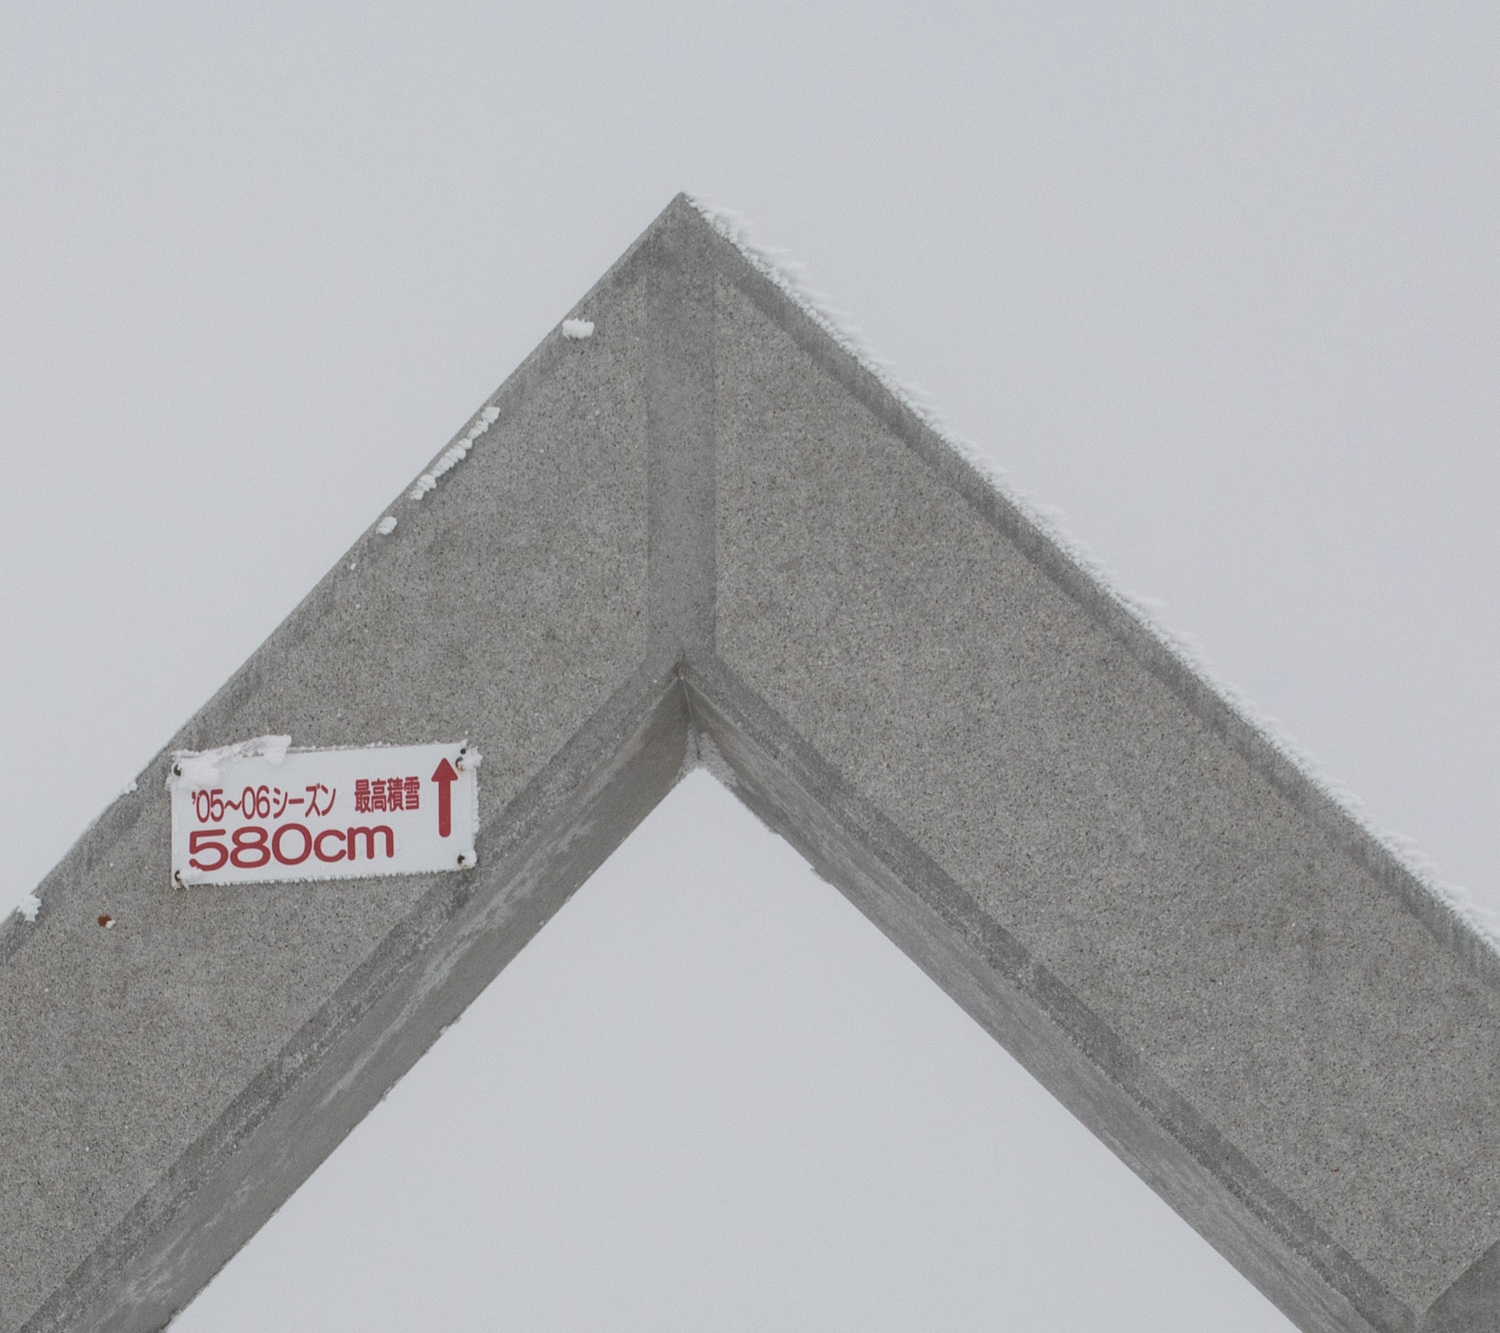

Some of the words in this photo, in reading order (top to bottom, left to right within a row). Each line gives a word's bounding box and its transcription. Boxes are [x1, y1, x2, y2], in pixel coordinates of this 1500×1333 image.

[354, 776, 421, 814] 最高積雪
[188, 823, 395, 872] 580cm
